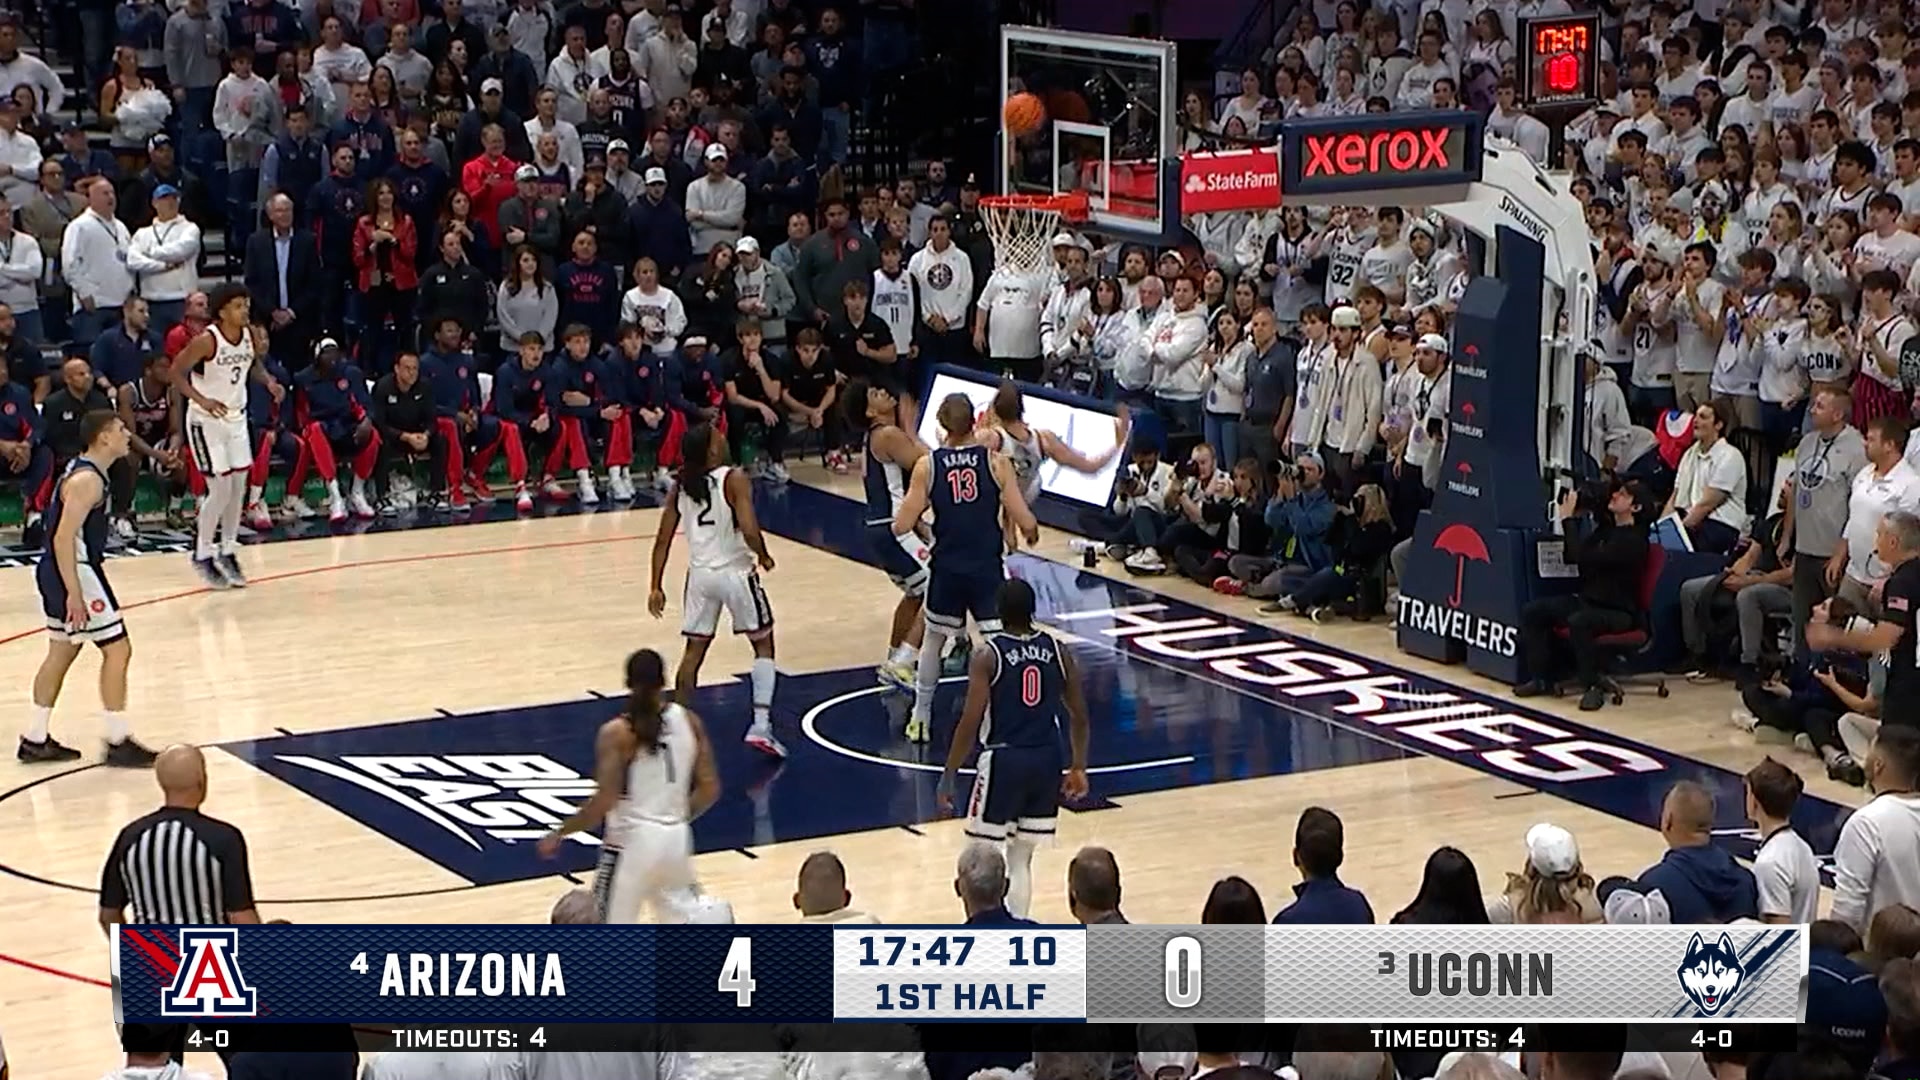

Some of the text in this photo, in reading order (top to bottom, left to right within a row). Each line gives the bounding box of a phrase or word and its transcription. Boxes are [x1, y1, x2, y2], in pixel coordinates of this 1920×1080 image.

[1539, 26, 1587, 54] 17:47
[1550, 54, 1578, 90] 10
[1306, 128, 1449, 177] xerox
[1498, 195, 1549, 243] SPALDING
[1331, 264, 1354, 287] 32
[1636, 325, 1651, 349] 21
[230, 366, 242, 385] 3
[947, 467, 979, 504] 13
[1397, 594, 1518, 657] TRAVELERS
[1005, 645, 1054, 667] BRADLEY
[1022, 665, 1041, 707] 0
[1055, 602, 1669, 783] HUSKIES
